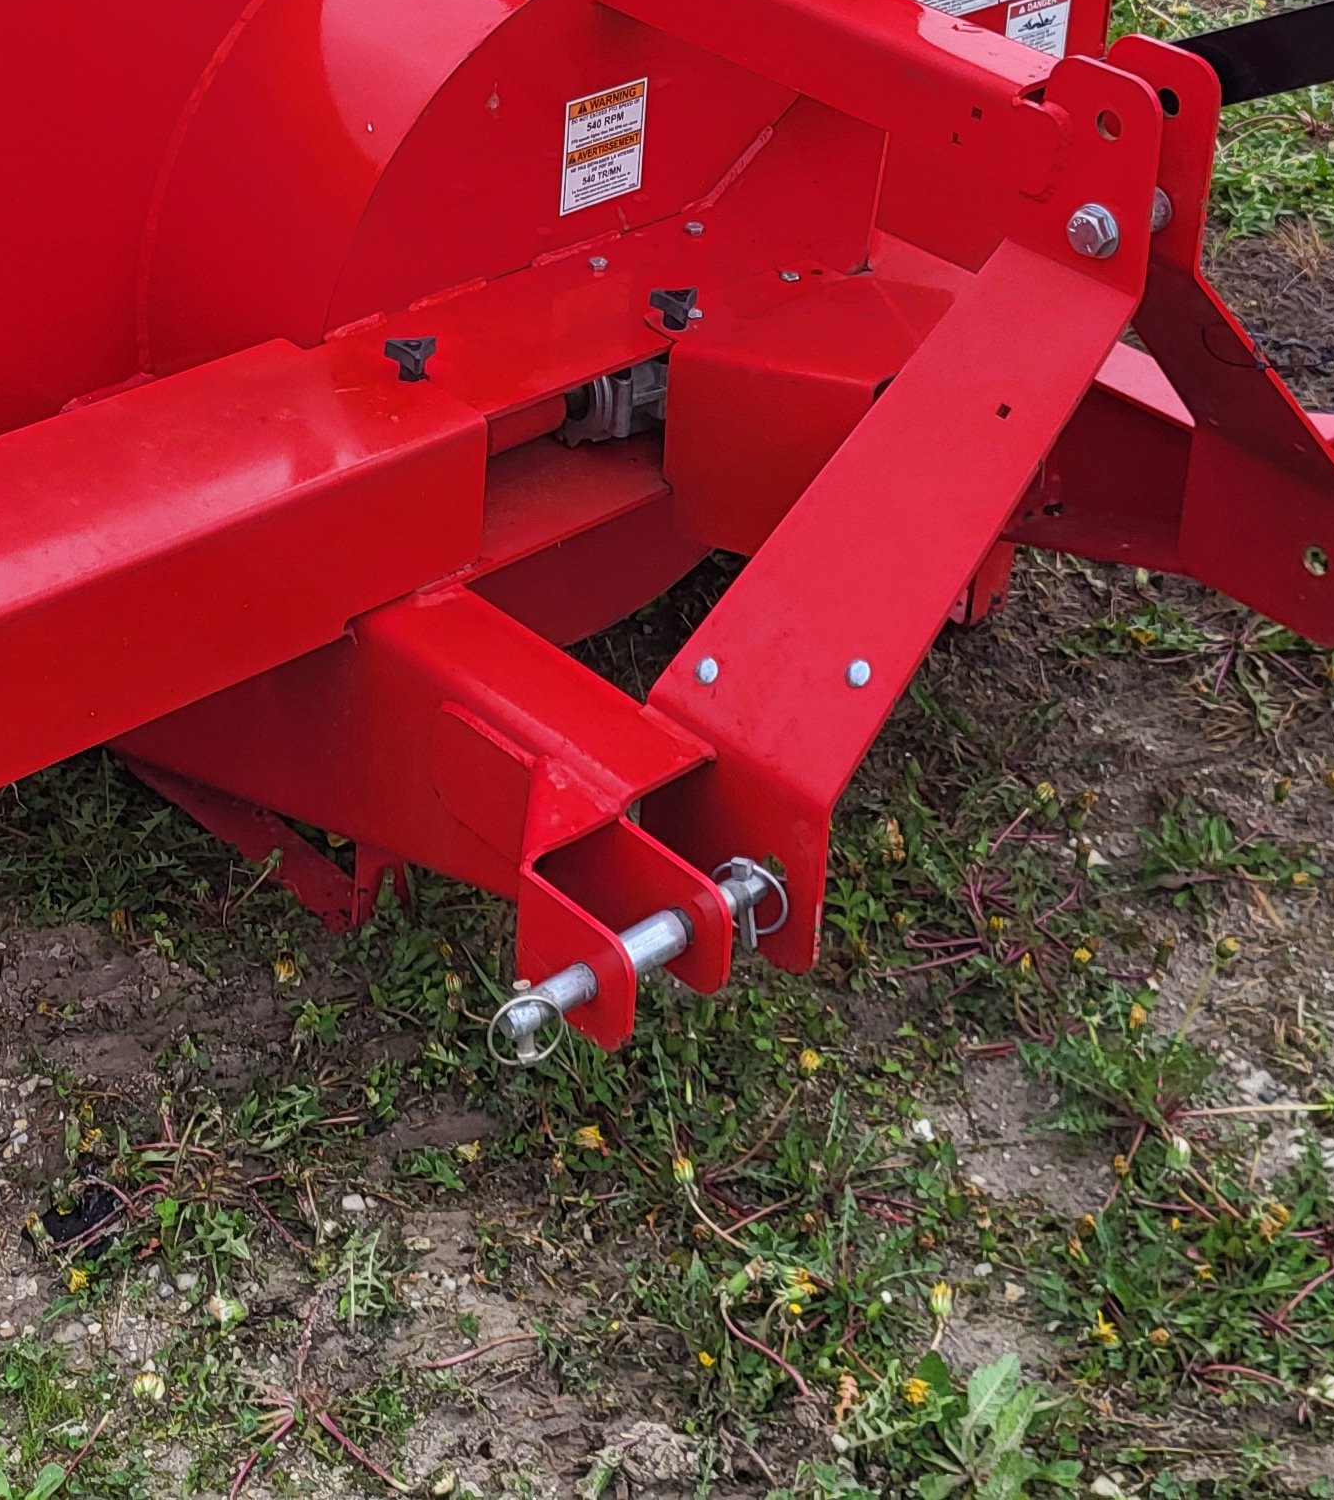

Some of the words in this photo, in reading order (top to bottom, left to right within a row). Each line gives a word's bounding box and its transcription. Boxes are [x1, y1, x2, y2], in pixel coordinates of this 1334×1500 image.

[589, 87, 637, 111] WARNING
[586, 119, 602, 132] 540
[604, 111, 625, 126] RPM
[589, 109, 607, 119] EXCEED
[577, 133, 639, 161] AVERTISSEMENT
[582, 174, 596, 185] 540
[598, 165, 622, 179] TR/MN
